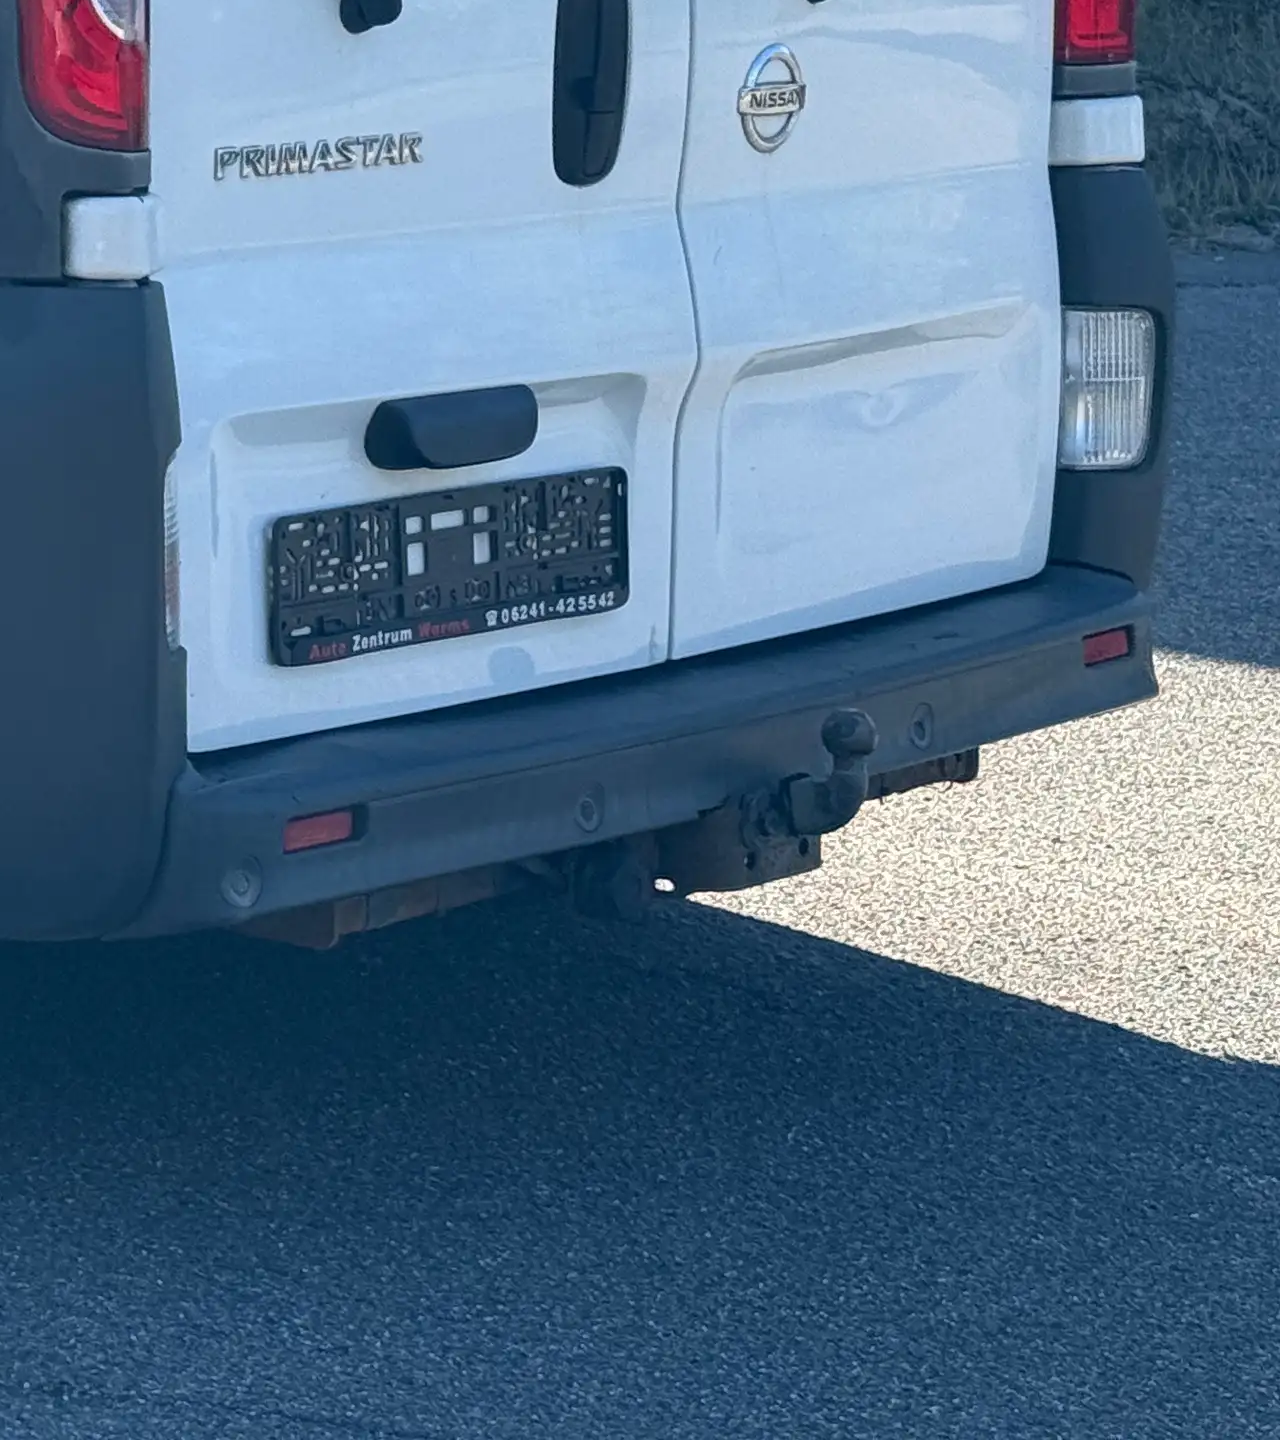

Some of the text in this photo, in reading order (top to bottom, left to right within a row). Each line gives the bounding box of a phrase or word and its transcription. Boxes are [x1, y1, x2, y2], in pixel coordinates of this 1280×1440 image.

[213, 131, 424, 181] PRIMASTAR
[352, 627, 413, 652] Zentrum
[501, 591, 615, 624] 06241-425542
